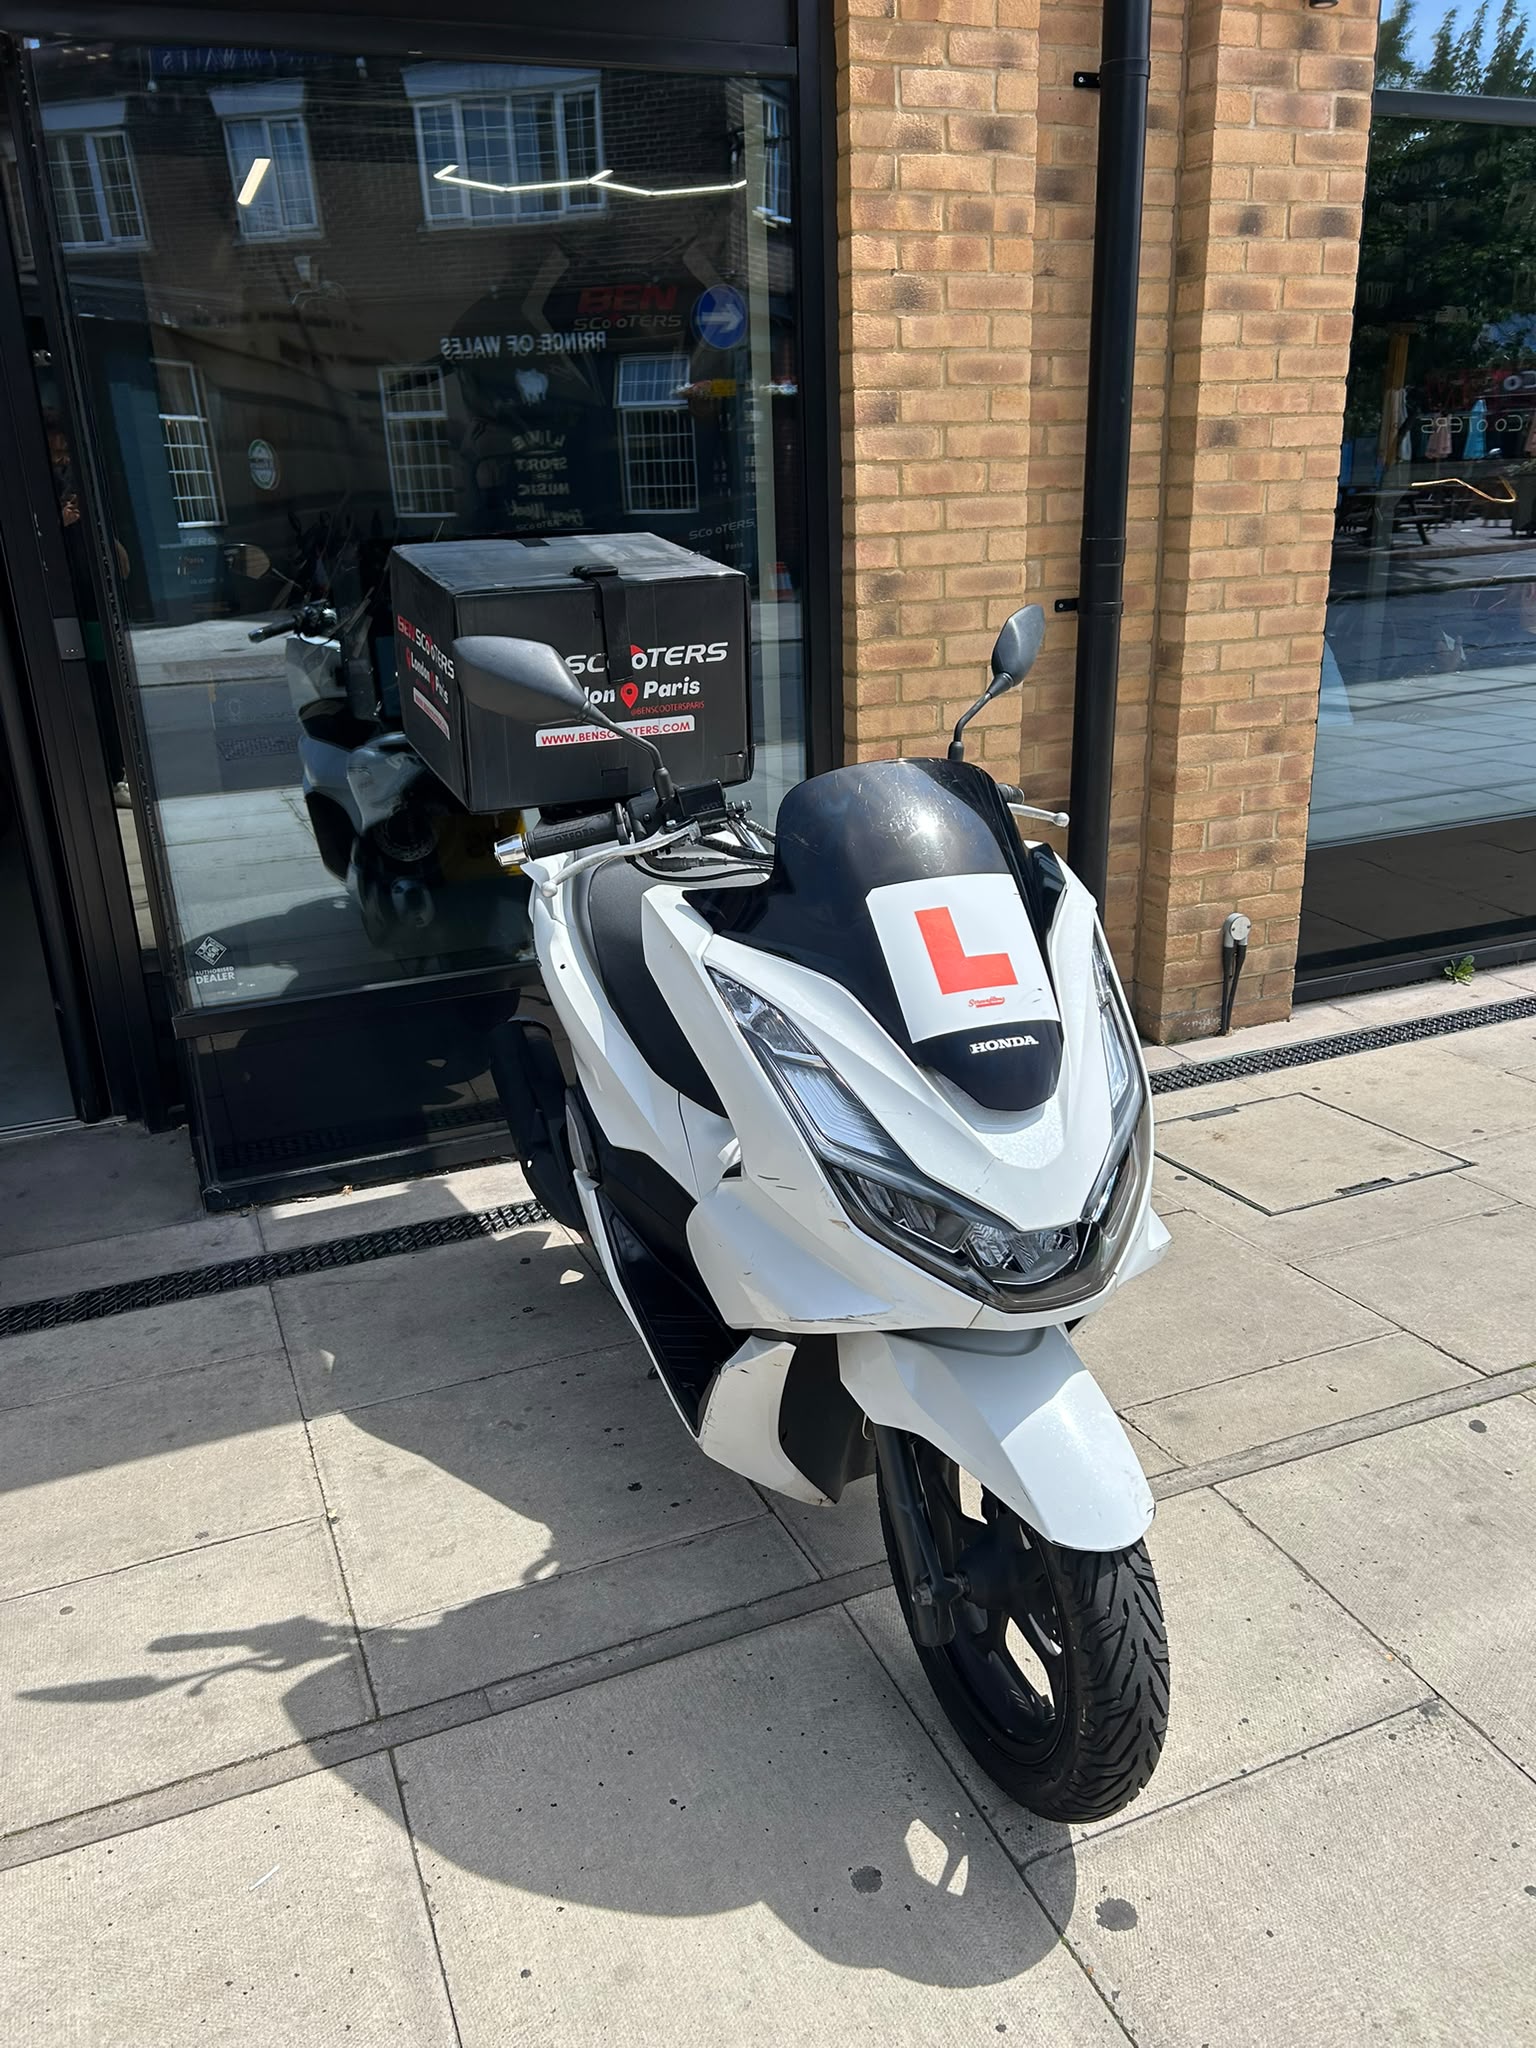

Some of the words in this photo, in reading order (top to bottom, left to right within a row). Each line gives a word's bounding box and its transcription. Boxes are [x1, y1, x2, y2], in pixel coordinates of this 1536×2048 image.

[577, 283, 679, 314] BEN
[410, 650, 431, 684] London
[565, 641, 729, 675] SCOTERS
[643, 675, 702, 700] Paris
[630, 700, 705, 717] @BENSCOOTERSPARIS
[914, 906, 1019, 996] L
[195, 965, 235, 976] AUTHORISED
[195, 972, 236, 985] DEALER
[968, 1034, 1040, 1055] HONDA
